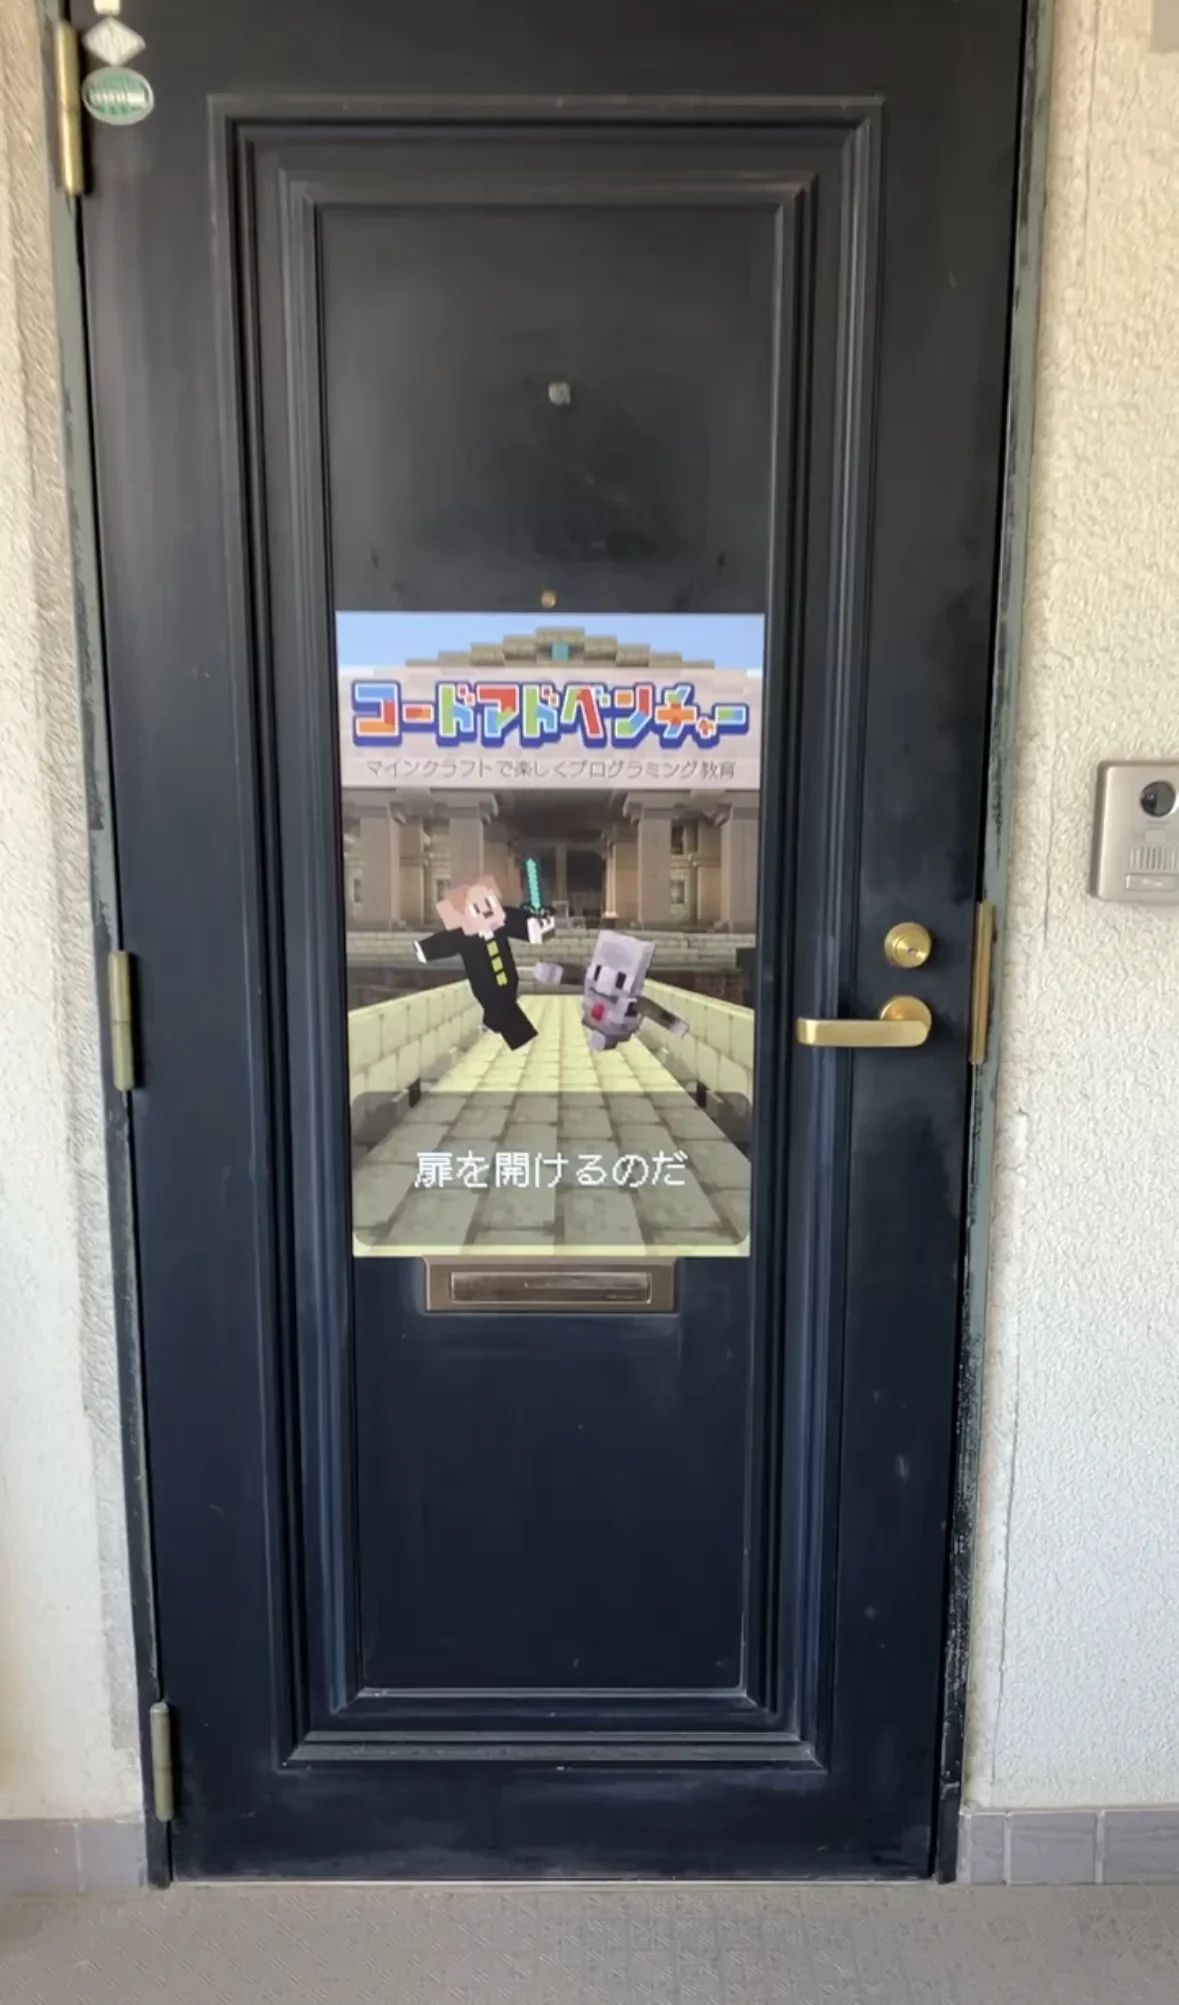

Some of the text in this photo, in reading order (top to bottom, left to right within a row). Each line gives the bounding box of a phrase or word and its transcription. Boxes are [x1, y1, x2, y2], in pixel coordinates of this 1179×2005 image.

[352, 681, 749, 748] コードアドベンチャー
[367, 760, 736, 780] マインクラフトで楽しくプログラミング教育
[414, 1150, 688, 1188] 扉を開けるのだ
